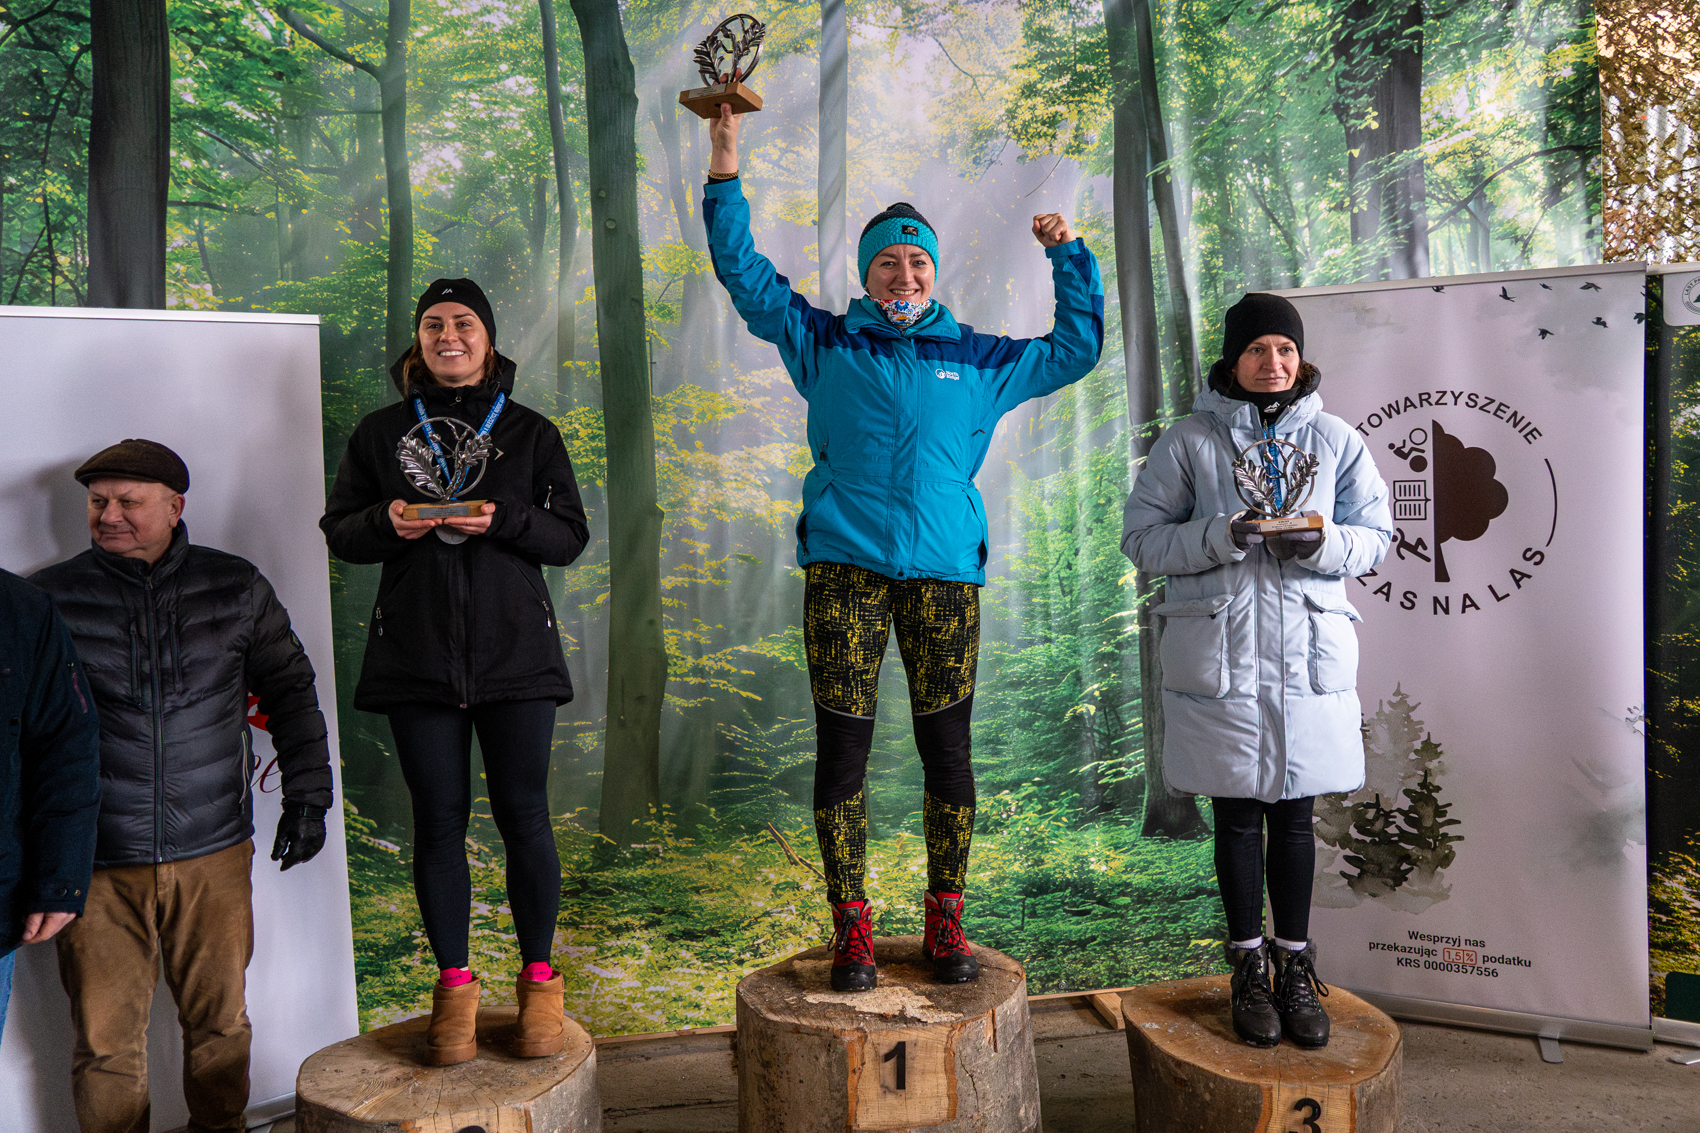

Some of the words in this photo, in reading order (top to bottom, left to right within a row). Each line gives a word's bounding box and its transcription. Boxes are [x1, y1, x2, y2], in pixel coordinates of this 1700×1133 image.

[1355, 390, 1542, 445] TOWARZYSZENIE
[1355, 568, 1417, 610] ZAS
[1433, 593, 1480, 615] NA
[1487, 547, 1545, 602] LAS
[1368, 941, 1438, 958] przekazując
[1482, 953, 1532, 968] podatku
[1407, 930, 1461, 947] Wesprzyj
[1465, 937, 1486, 948] nas
[1396, 957, 1420, 969] KRS
[1423, 961, 1499, 978] 0000357556
[884, 1041, 906, 1090] 1
[1288, 1097, 1321, 1133] 3
